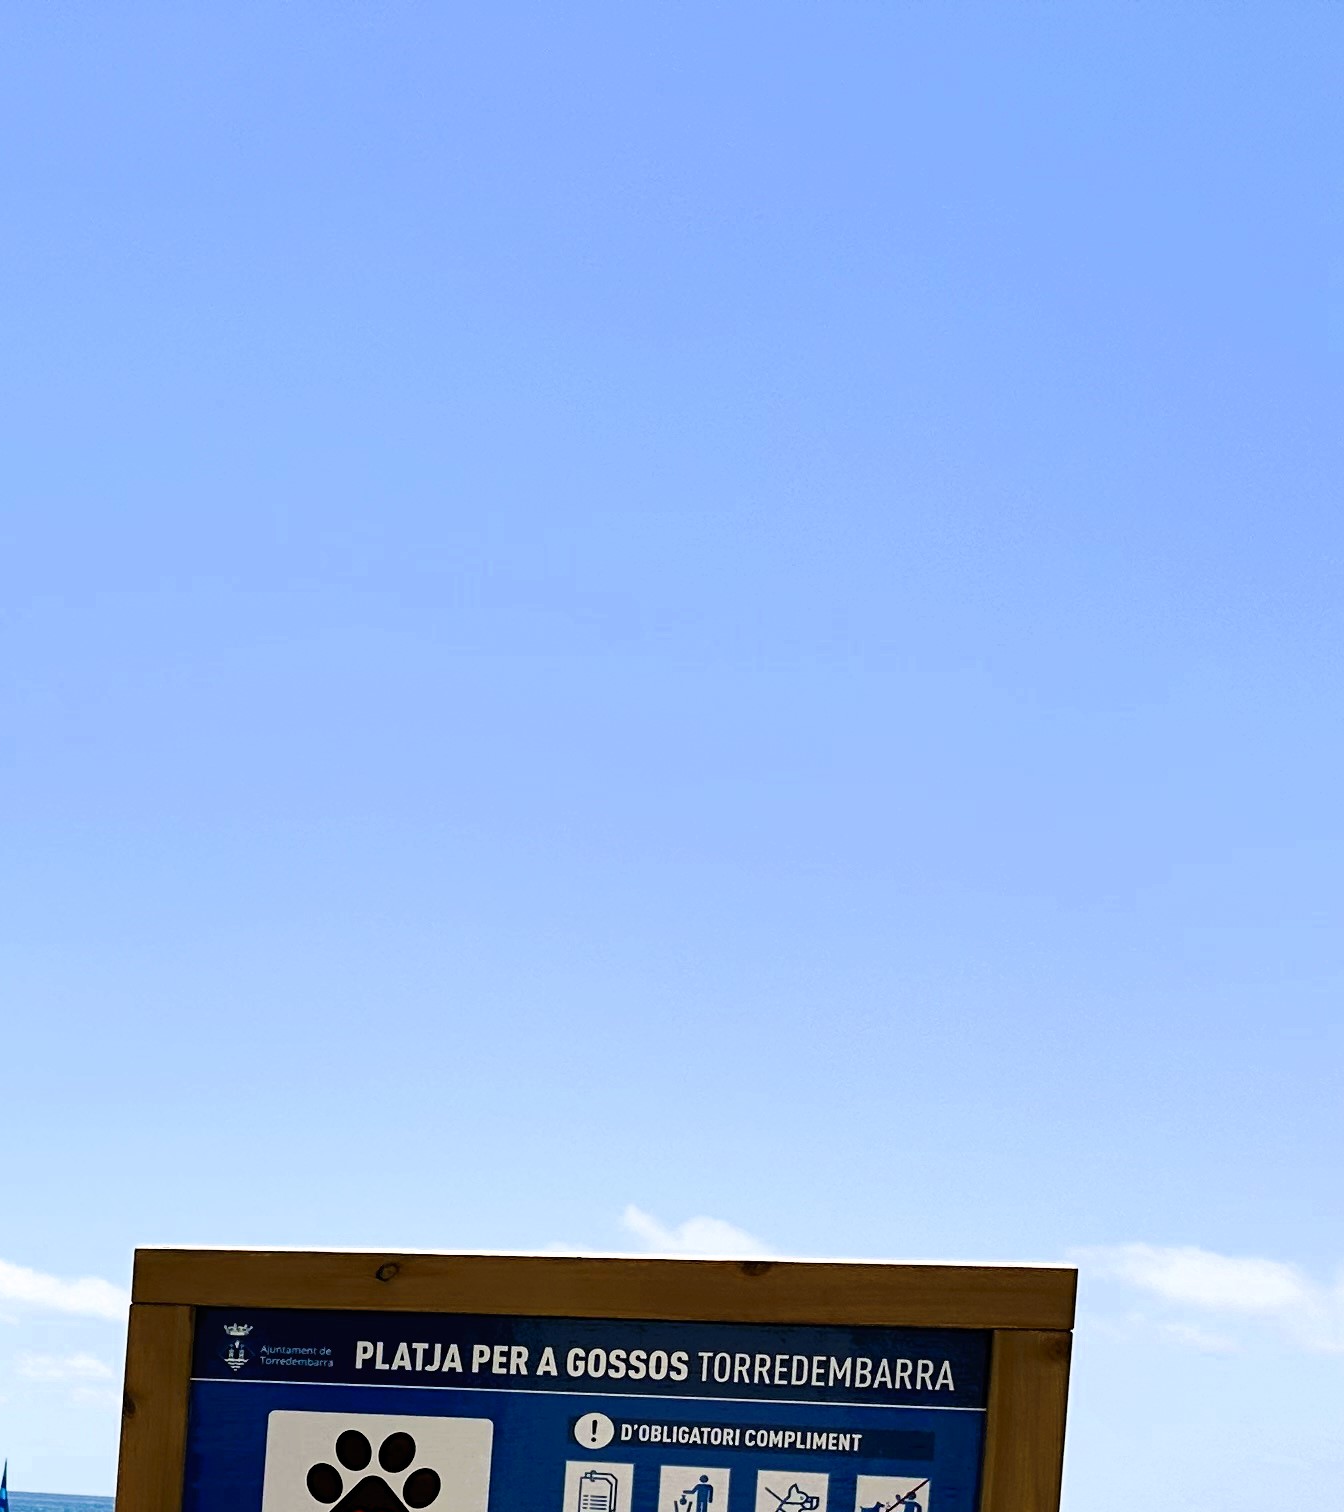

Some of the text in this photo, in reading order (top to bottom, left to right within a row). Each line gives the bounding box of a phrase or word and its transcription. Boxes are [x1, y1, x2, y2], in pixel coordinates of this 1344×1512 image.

[260, 1345, 332, 1355] Ajuntament de
[260, 1356, 334, 1368] Torredembarra
[355, 1340, 955, 1391] PLATJA PER A GOSSOS TORREDEMBARRA
[620, 1424, 862, 1452] D'OBLIGATORI COMPLIMENT
